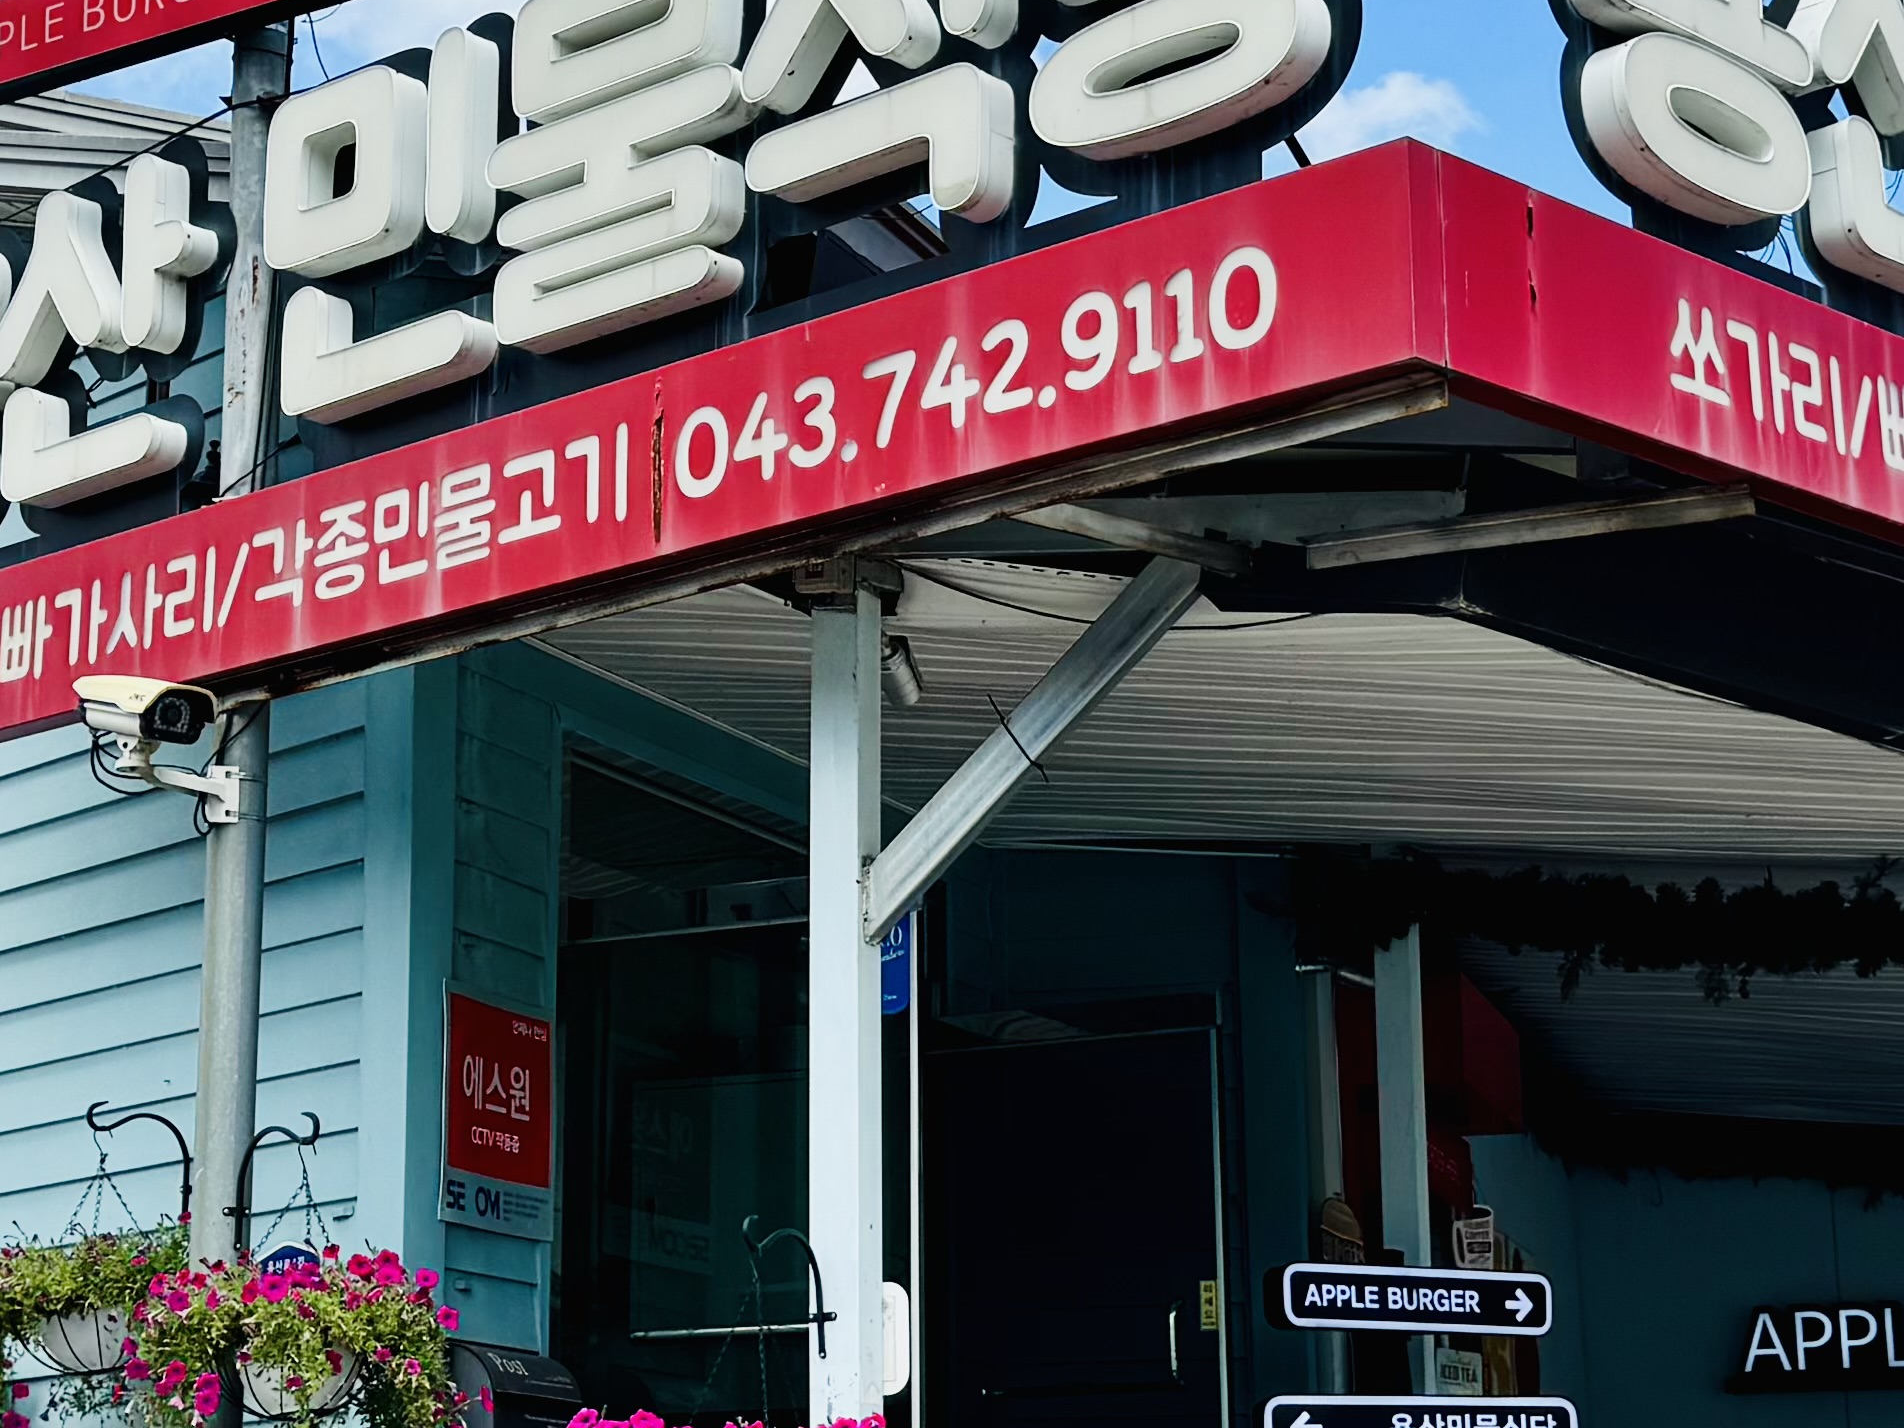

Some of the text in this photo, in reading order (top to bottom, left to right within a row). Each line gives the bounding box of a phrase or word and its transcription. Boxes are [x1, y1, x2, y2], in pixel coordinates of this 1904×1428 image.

[675, 246, 1277, 498] 043.742.9110
[463, 1054, 530, 1121] 에스원
[1304, 1283, 1481, 1313] APPLE BURGER
